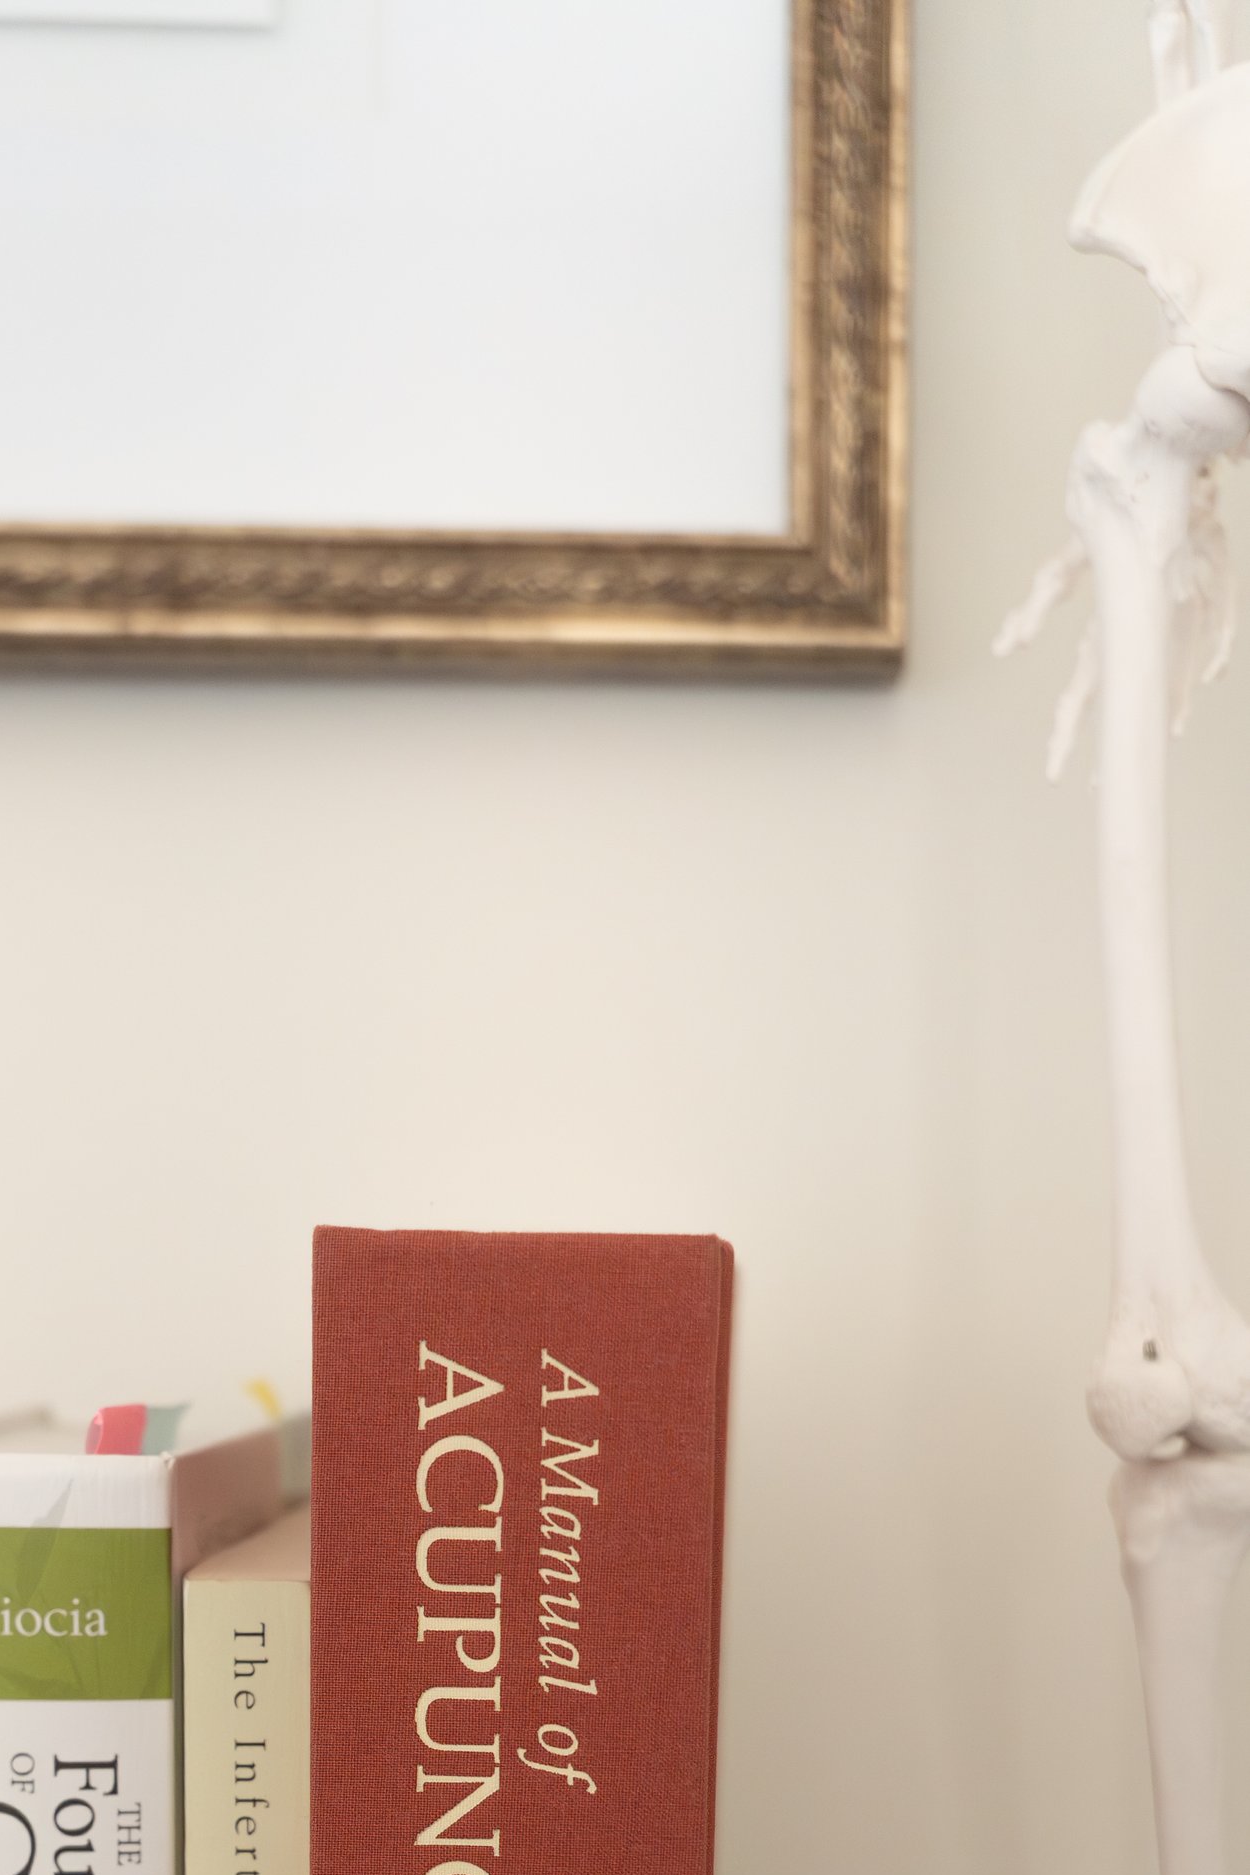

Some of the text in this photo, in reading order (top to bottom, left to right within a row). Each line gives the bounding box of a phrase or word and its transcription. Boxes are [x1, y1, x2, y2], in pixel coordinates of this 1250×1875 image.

[516, 1348, 601, 1796] A Manual of
[233, 1622, 269, 1711] The
[10, 1752, 36, 1794] OF
[117, 1802, 142, 1867] THE
